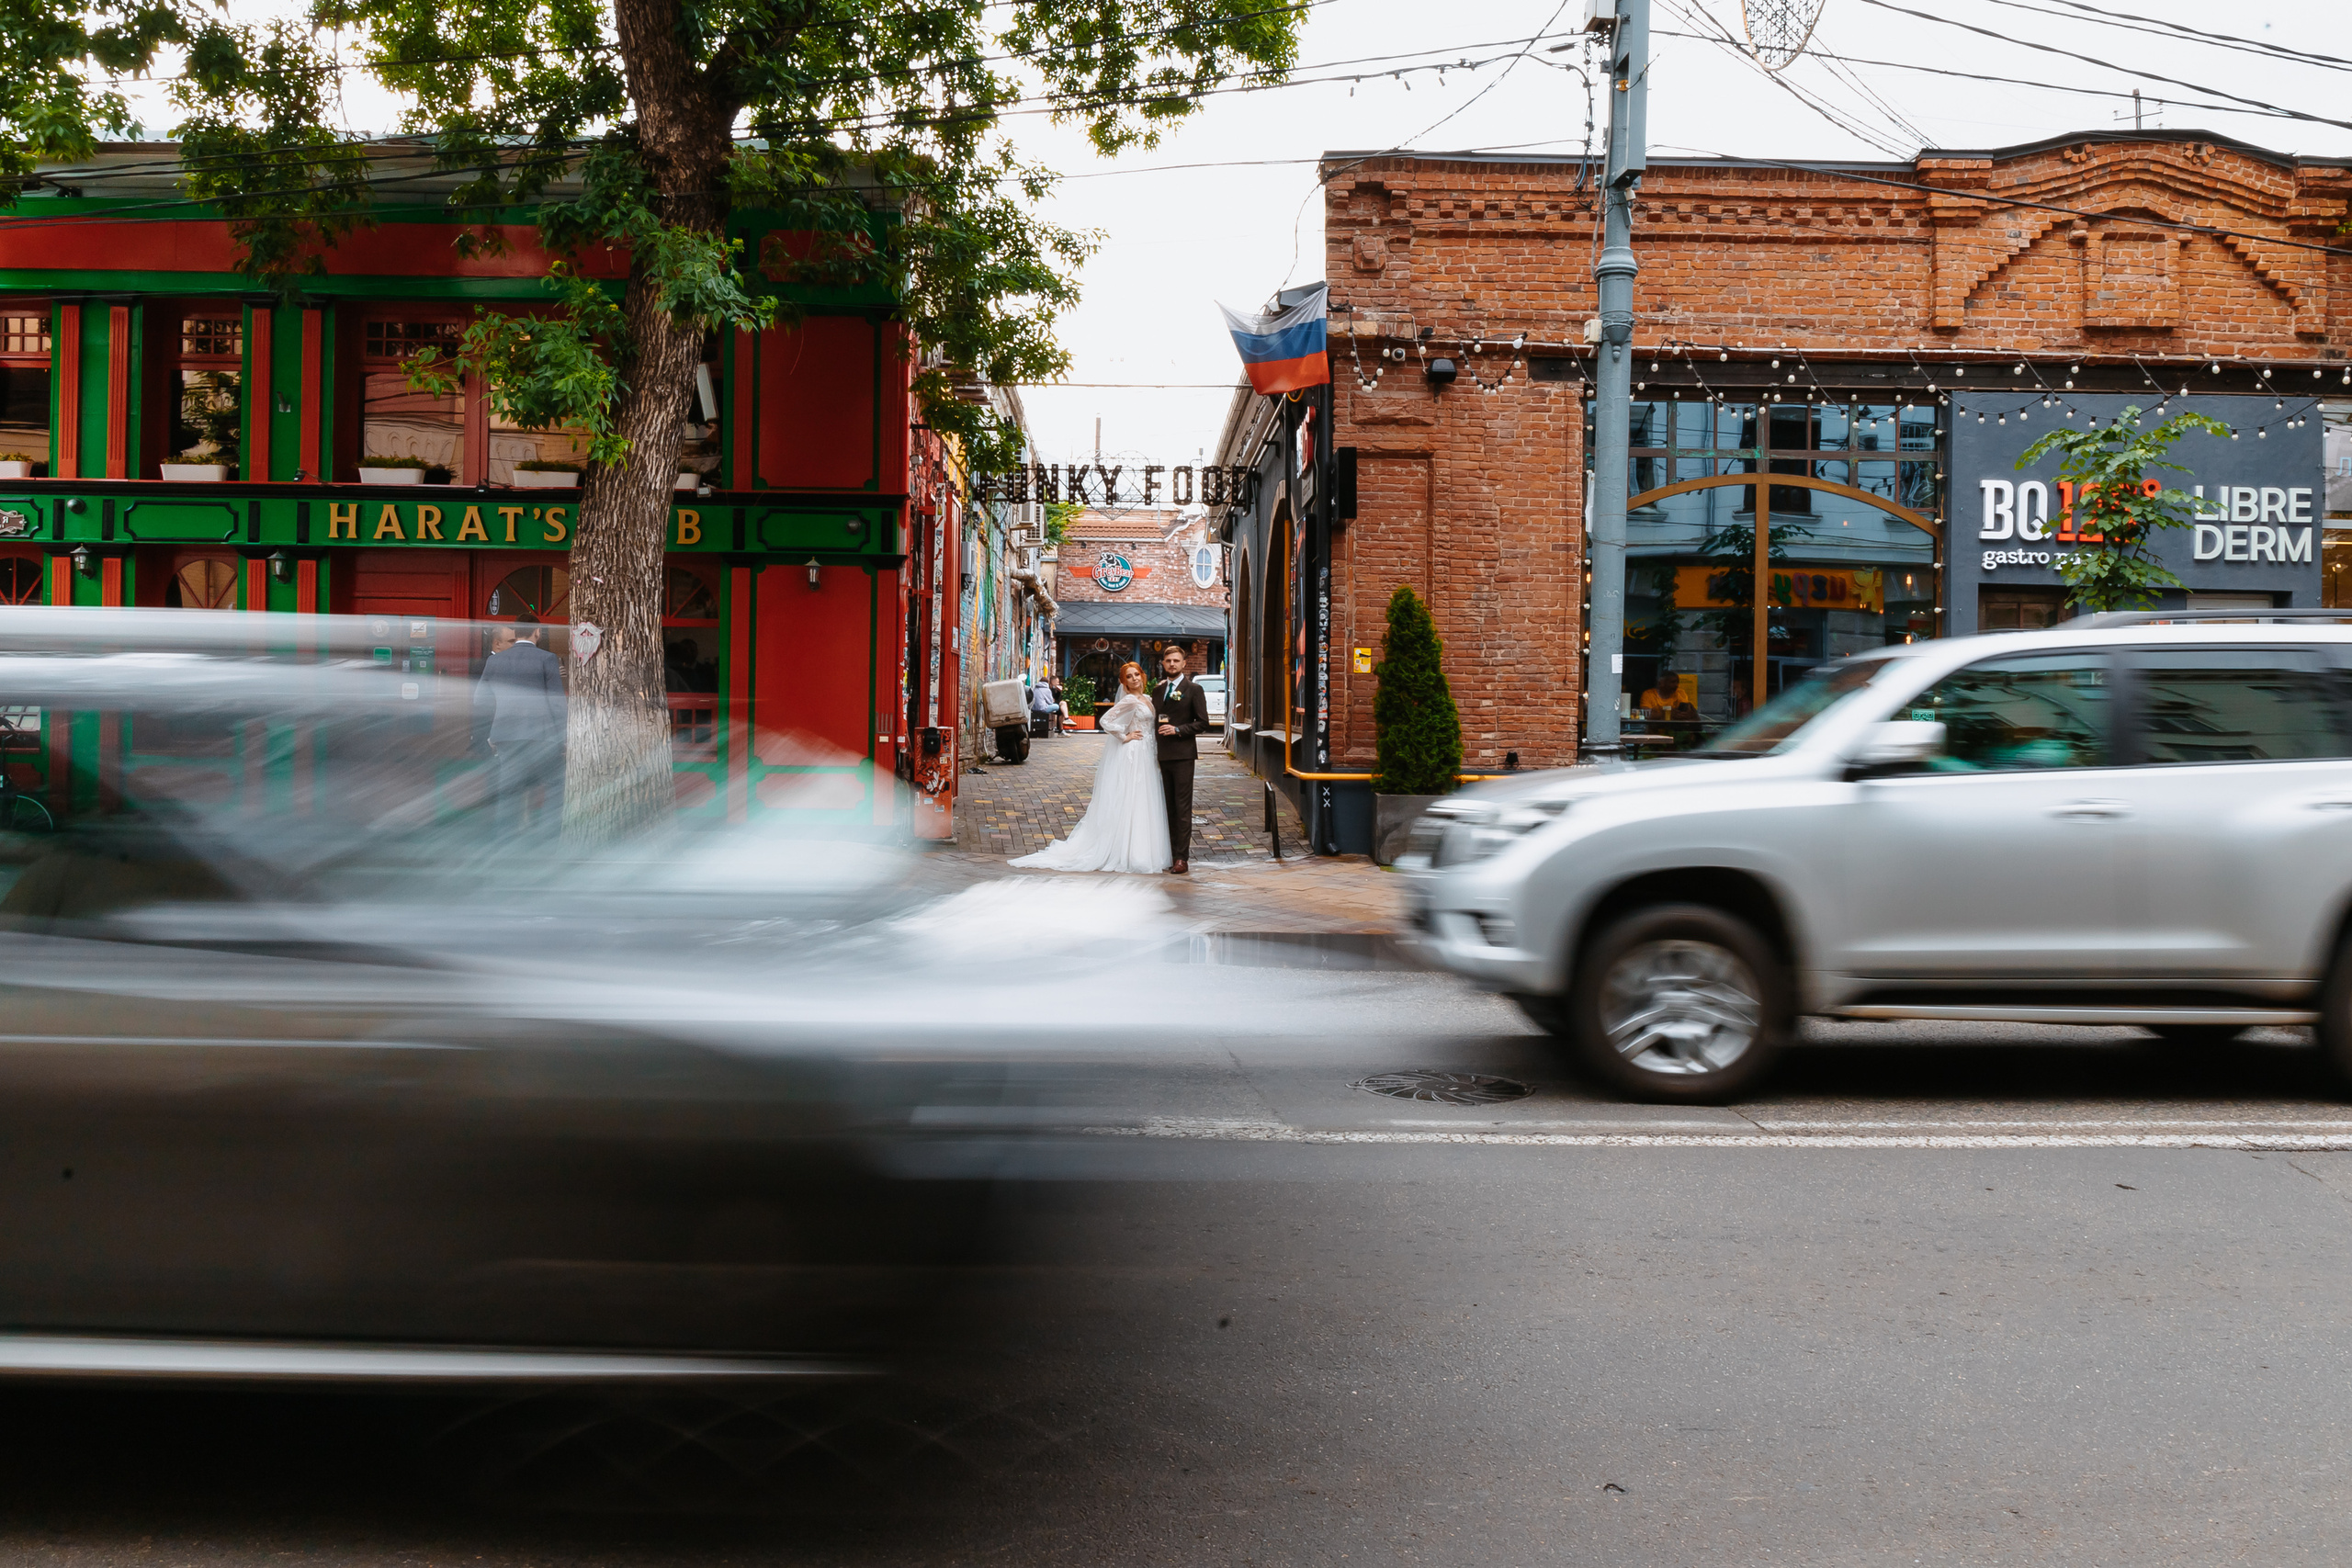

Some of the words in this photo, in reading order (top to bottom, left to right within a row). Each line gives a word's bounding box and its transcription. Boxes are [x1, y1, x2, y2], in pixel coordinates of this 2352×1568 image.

[328, 502, 569, 542] HARAT'S
[2194, 485, 2313, 524] LIBRE
[1981, 548, 2050, 570] gastro
[2194, 524, 2312, 563] DERM
